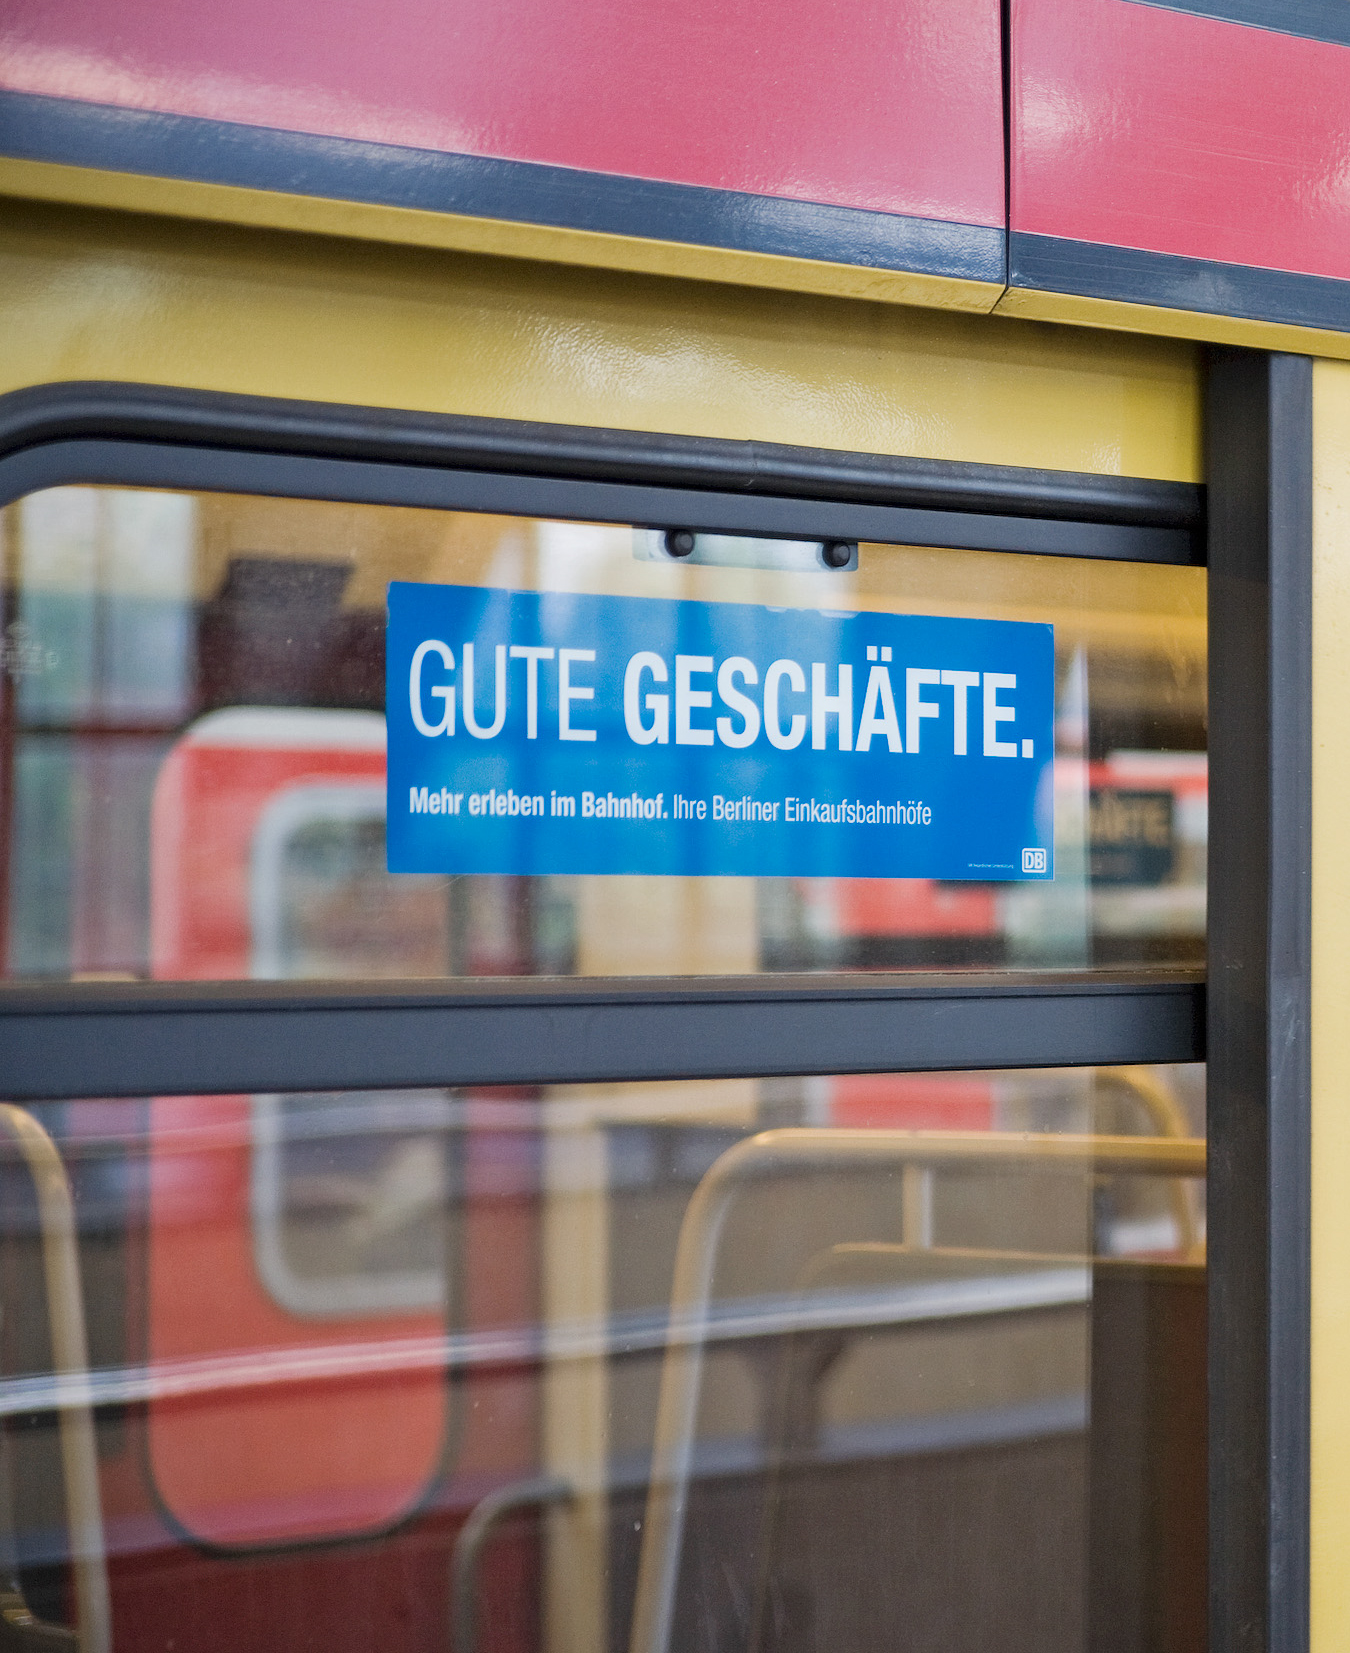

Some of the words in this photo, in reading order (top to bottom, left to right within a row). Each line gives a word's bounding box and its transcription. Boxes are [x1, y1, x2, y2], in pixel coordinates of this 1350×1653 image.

[409, 639, 597, 742] GUTE
[623, 645, 1034, 759] GESCHÄFTE.
[409, 786, 464, 815] Mehr
[468, 788, 545, 817] erleben
[550, 790, 576, 817] im
[581, 791, 669, 820] Bahnhof.
[673, 793, 707, 820] Ihre
[712, 794, 781, 822] Berliner
[784, 796, 932, 826] Einkaufsbahnhöfe
[1024, 851, 1044, 870] DB
